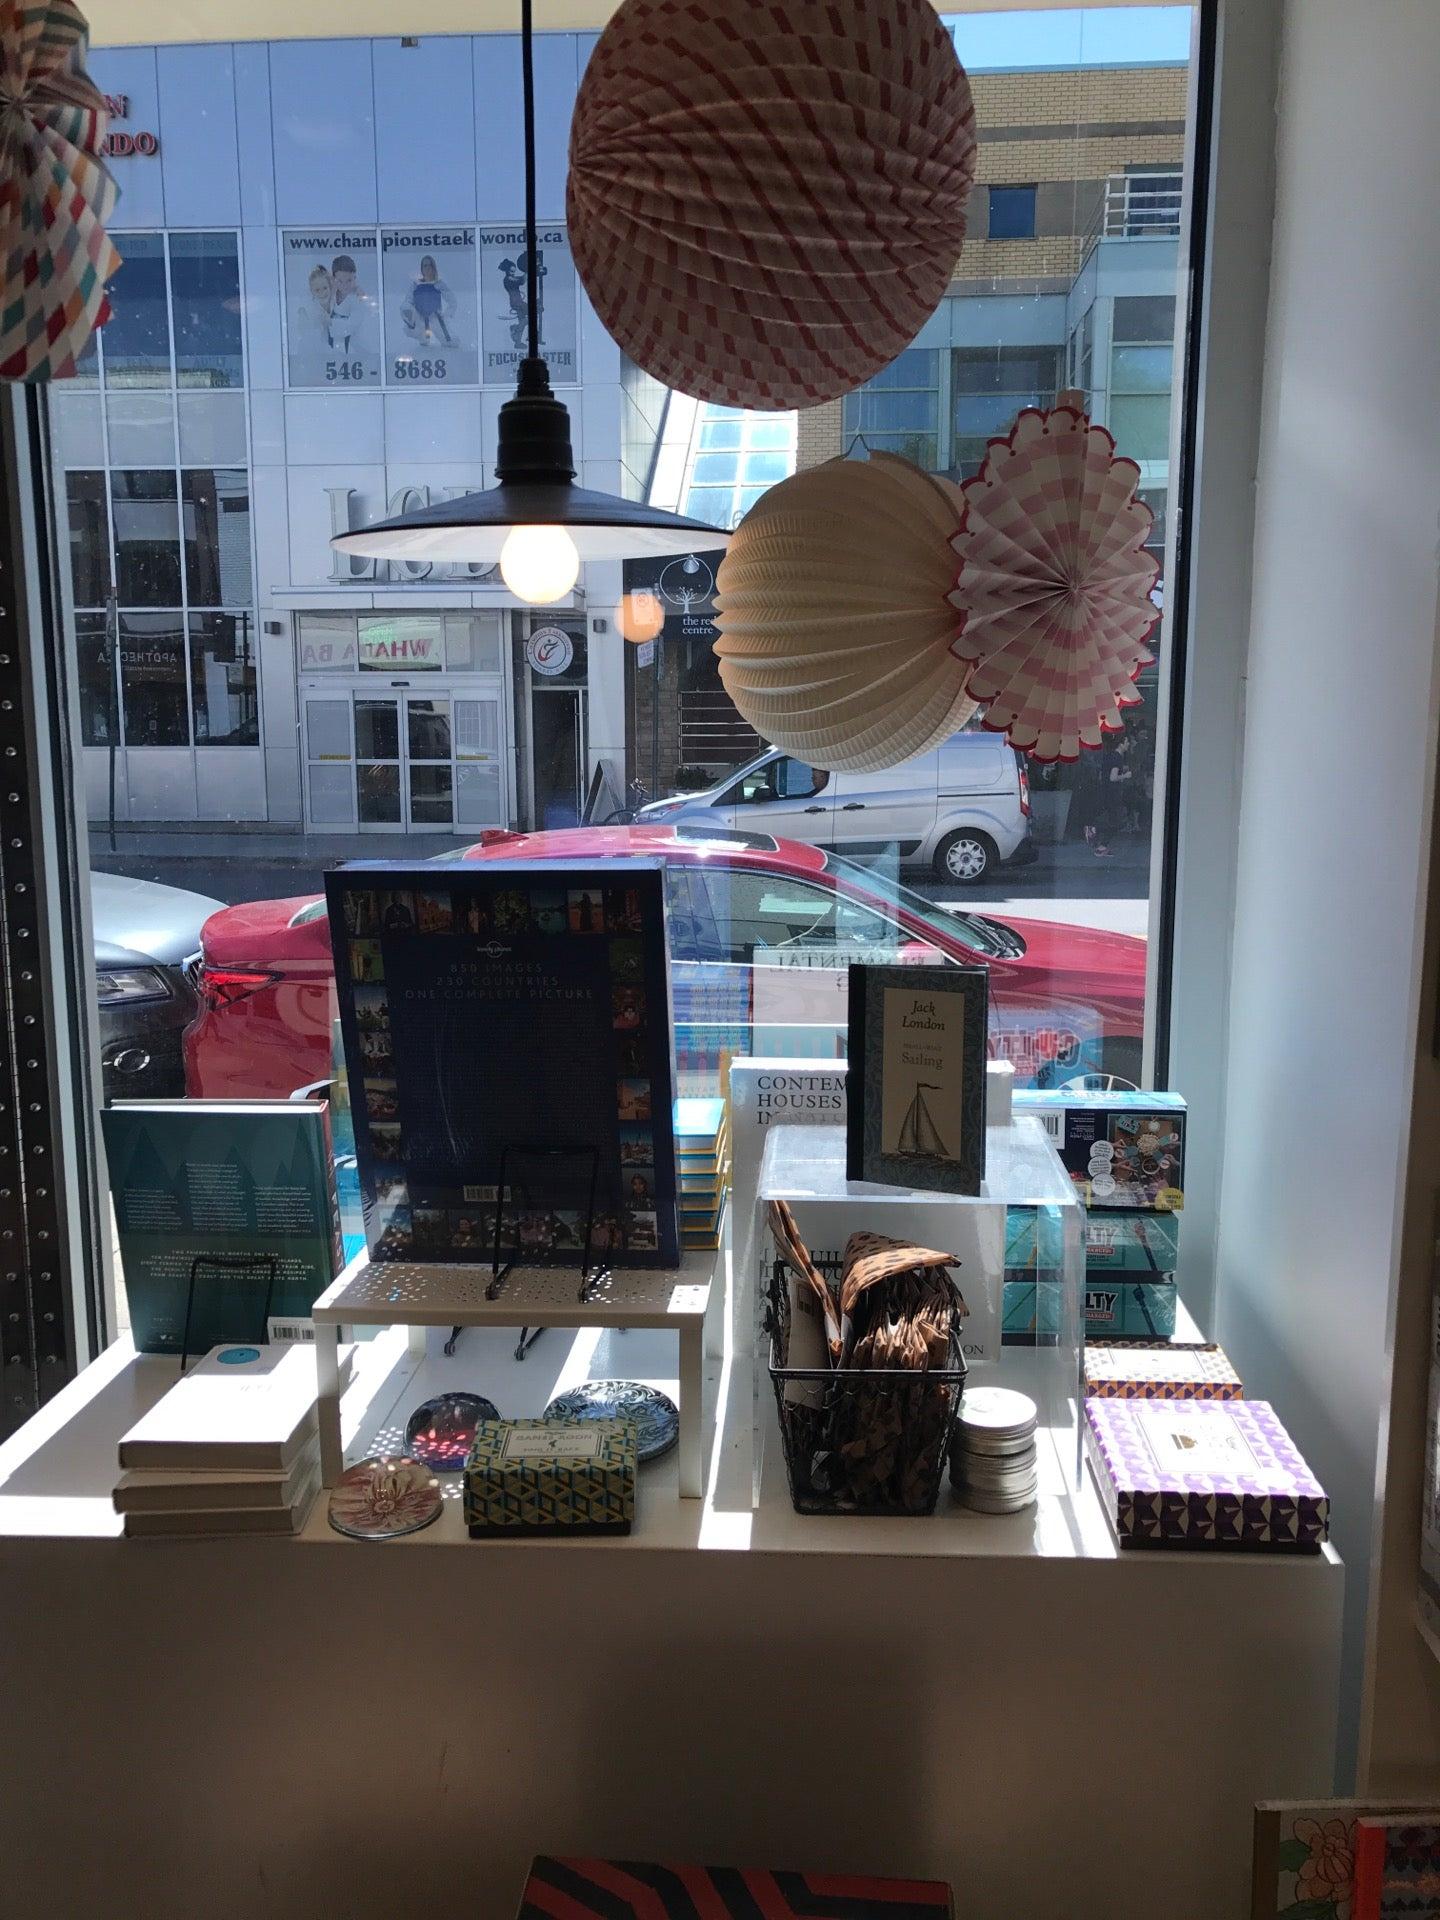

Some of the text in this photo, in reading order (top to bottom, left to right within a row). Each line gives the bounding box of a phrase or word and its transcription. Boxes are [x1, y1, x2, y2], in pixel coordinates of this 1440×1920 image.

[289, 231, 563, 252] www.championstaekwond.ca
[326, 361, 363, 380] 546
[394, 359, 447, 379] 8688
[683, 616, 701, 626] the
[682, 627, 714, 635] centre
[486, 963, 543, 973] IMAGES
[472, 976, 560, 986] COUNTRIES
[405, 989, 593, 1000] ONE COMPLETE PICTURE
[910, 1000, 936, 1016] Jack
[902, 1015, 945, 1031] London
[902, 1052, 943, 1071] Sailing
[757, 1094, 842, 1109] HOUSES
